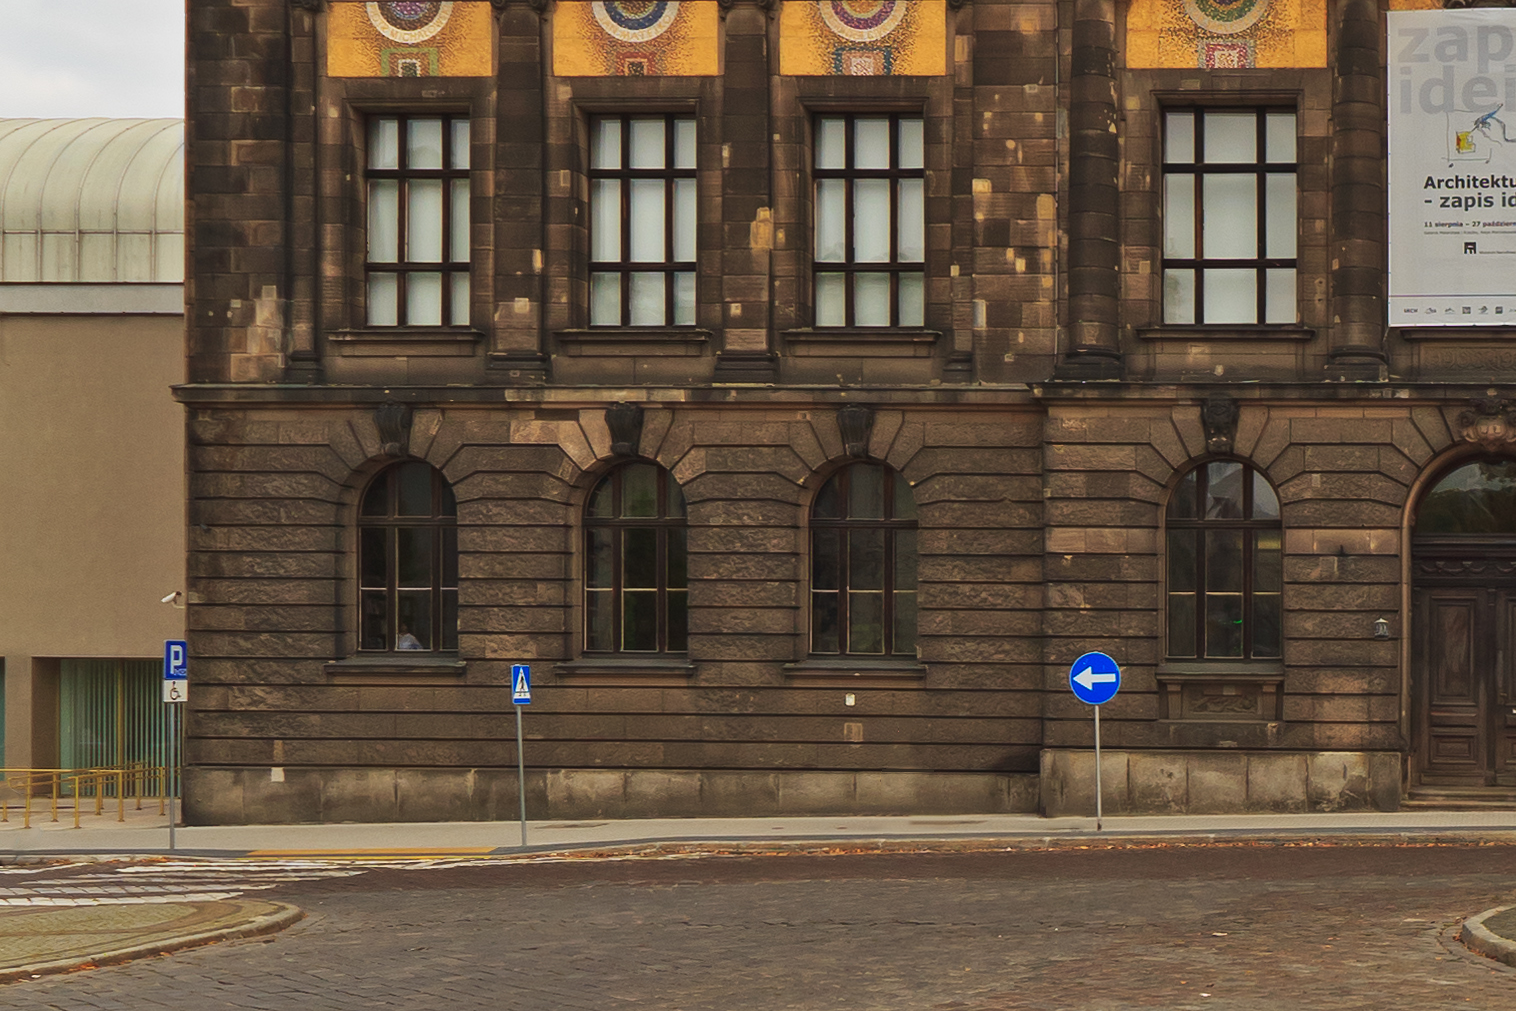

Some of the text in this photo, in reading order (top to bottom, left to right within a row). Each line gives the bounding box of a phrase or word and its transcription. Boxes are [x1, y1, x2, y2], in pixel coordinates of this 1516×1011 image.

[1399, 65, 1516, 114] idei
[1440, 192, 1494, 211] zapis
[170, 645, 183, 674] P
